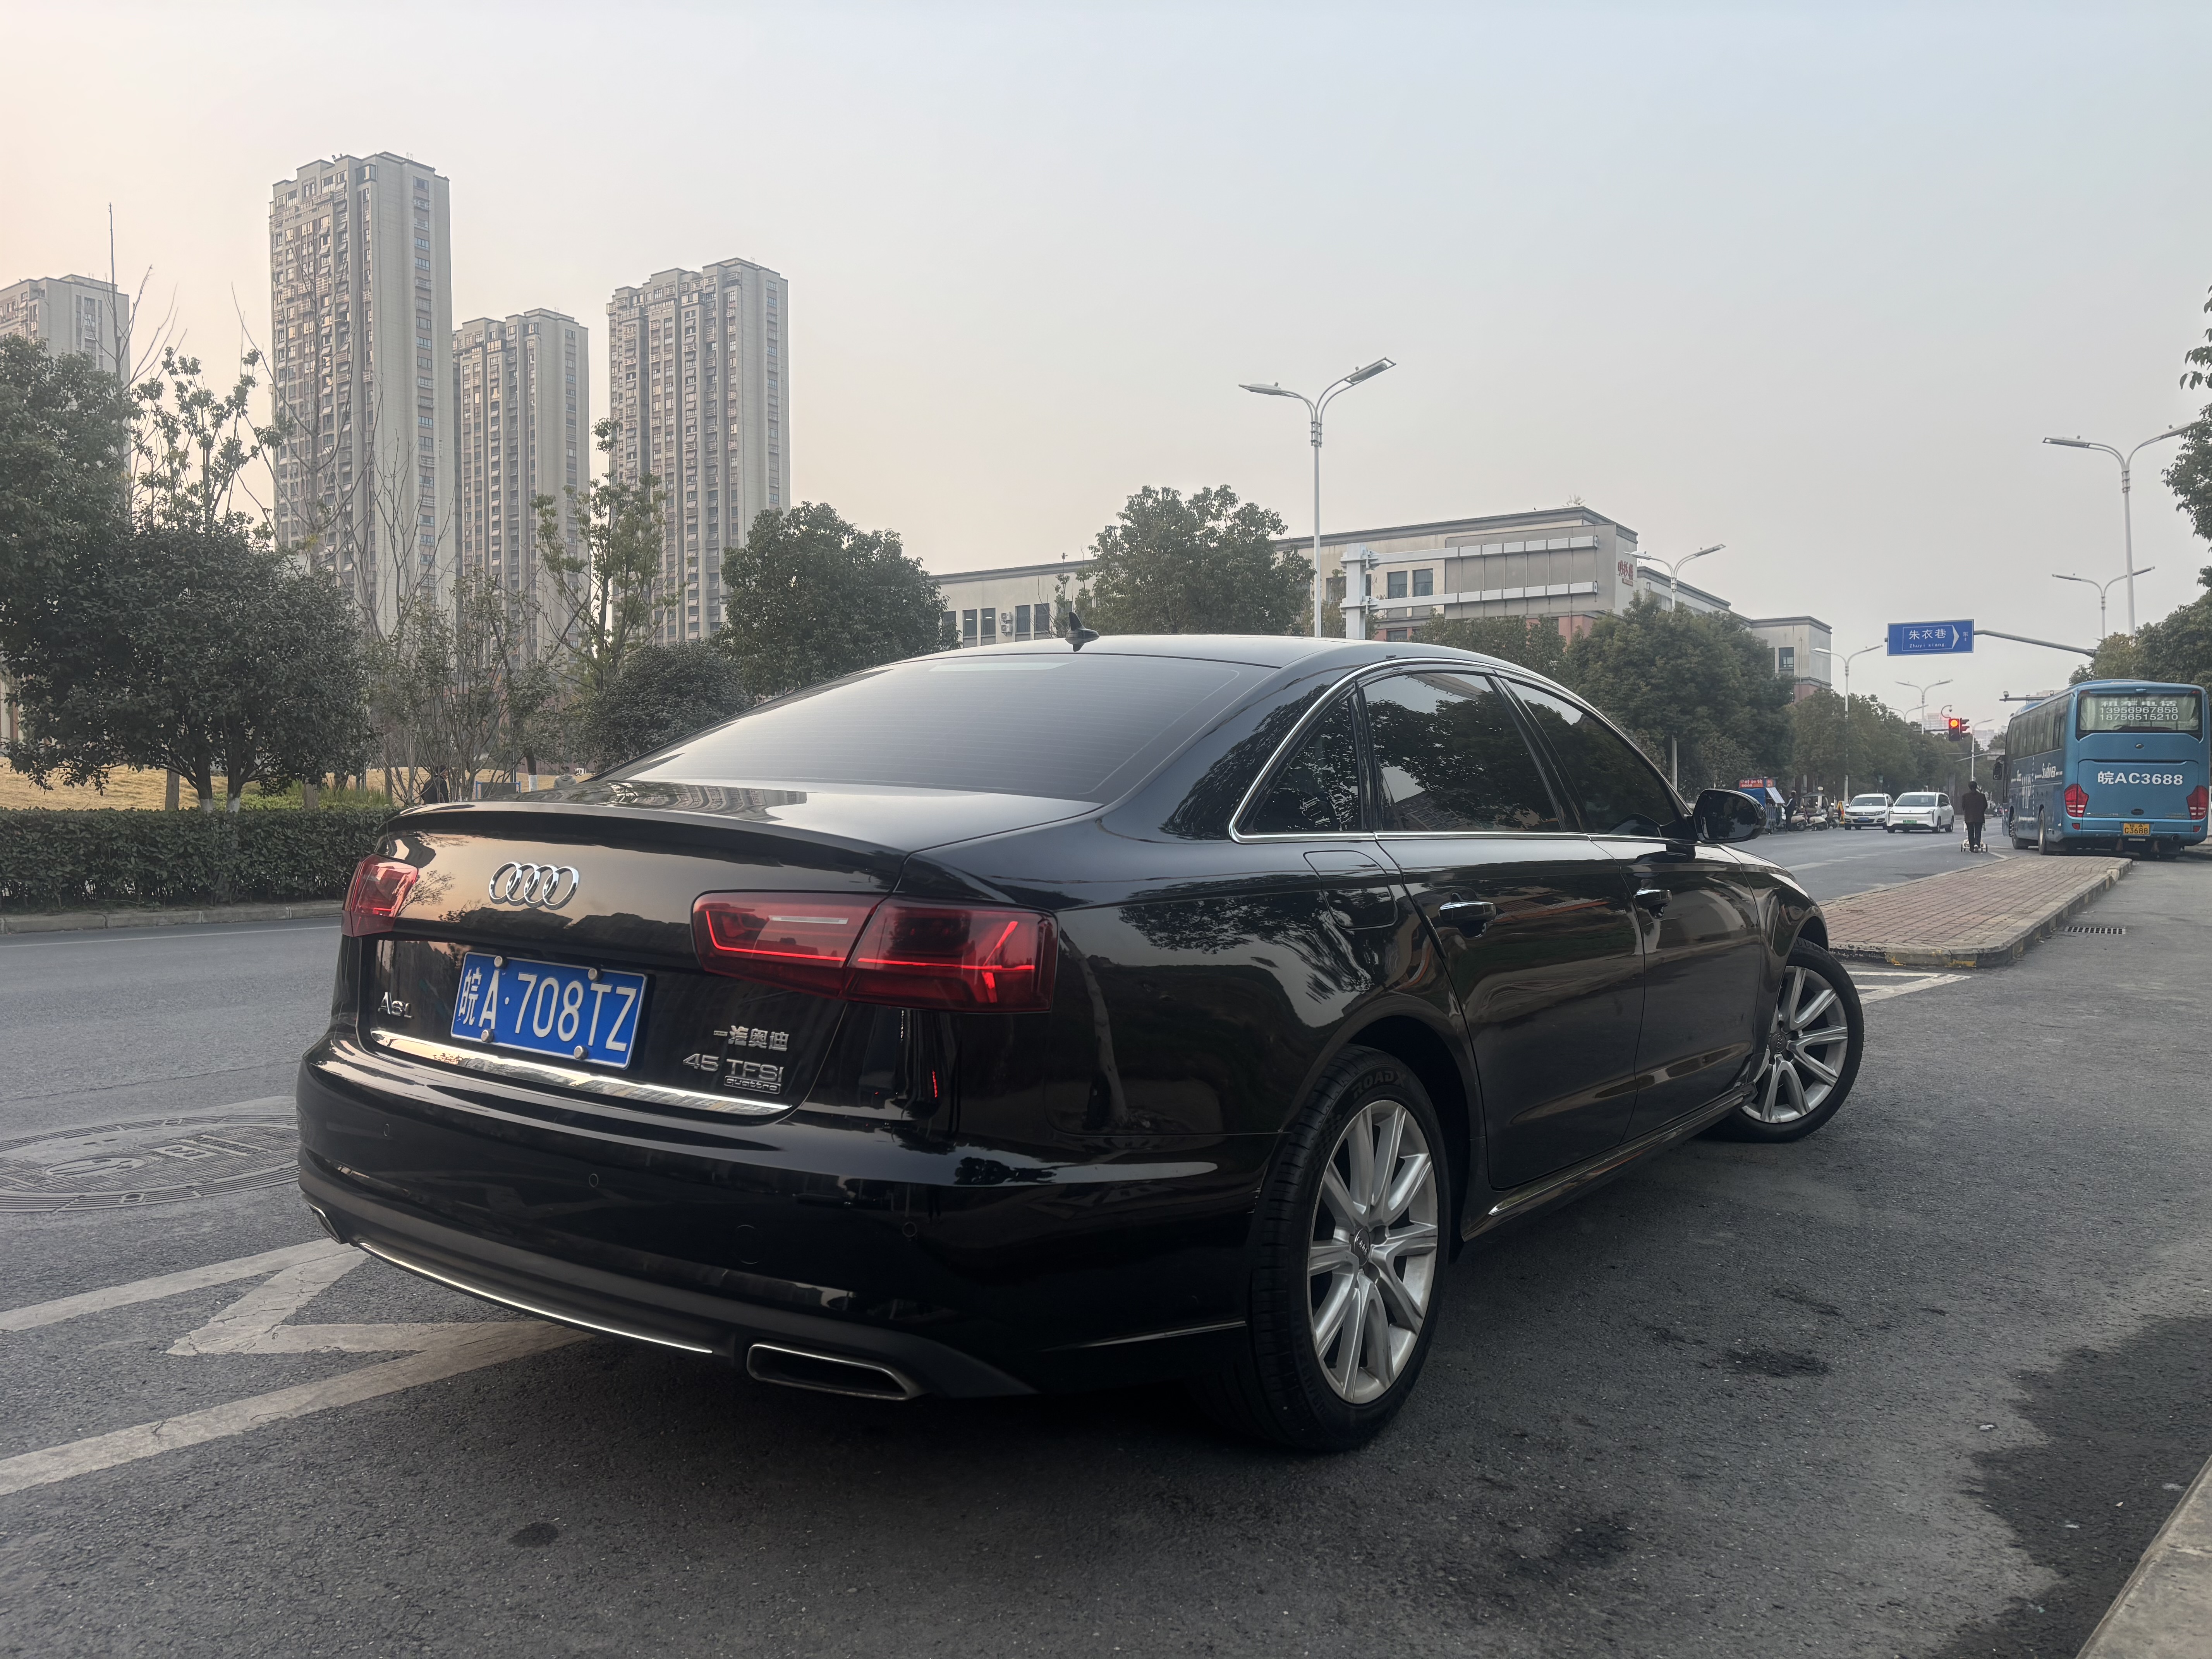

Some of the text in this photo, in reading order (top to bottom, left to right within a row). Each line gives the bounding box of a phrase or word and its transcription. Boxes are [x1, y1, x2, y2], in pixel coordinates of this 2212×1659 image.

[1909, 629, 1946, 640] 朱衣巷
[2098, 771, 2183, 785] 皖AC3688
[378, 992, 414, 1019] A6L
[713, 1025, 789, 1052] 一汽奥迪
[682, 1053, 784, 1083] 45 TFSI
[726, 1078, 778, 1092] quattro
